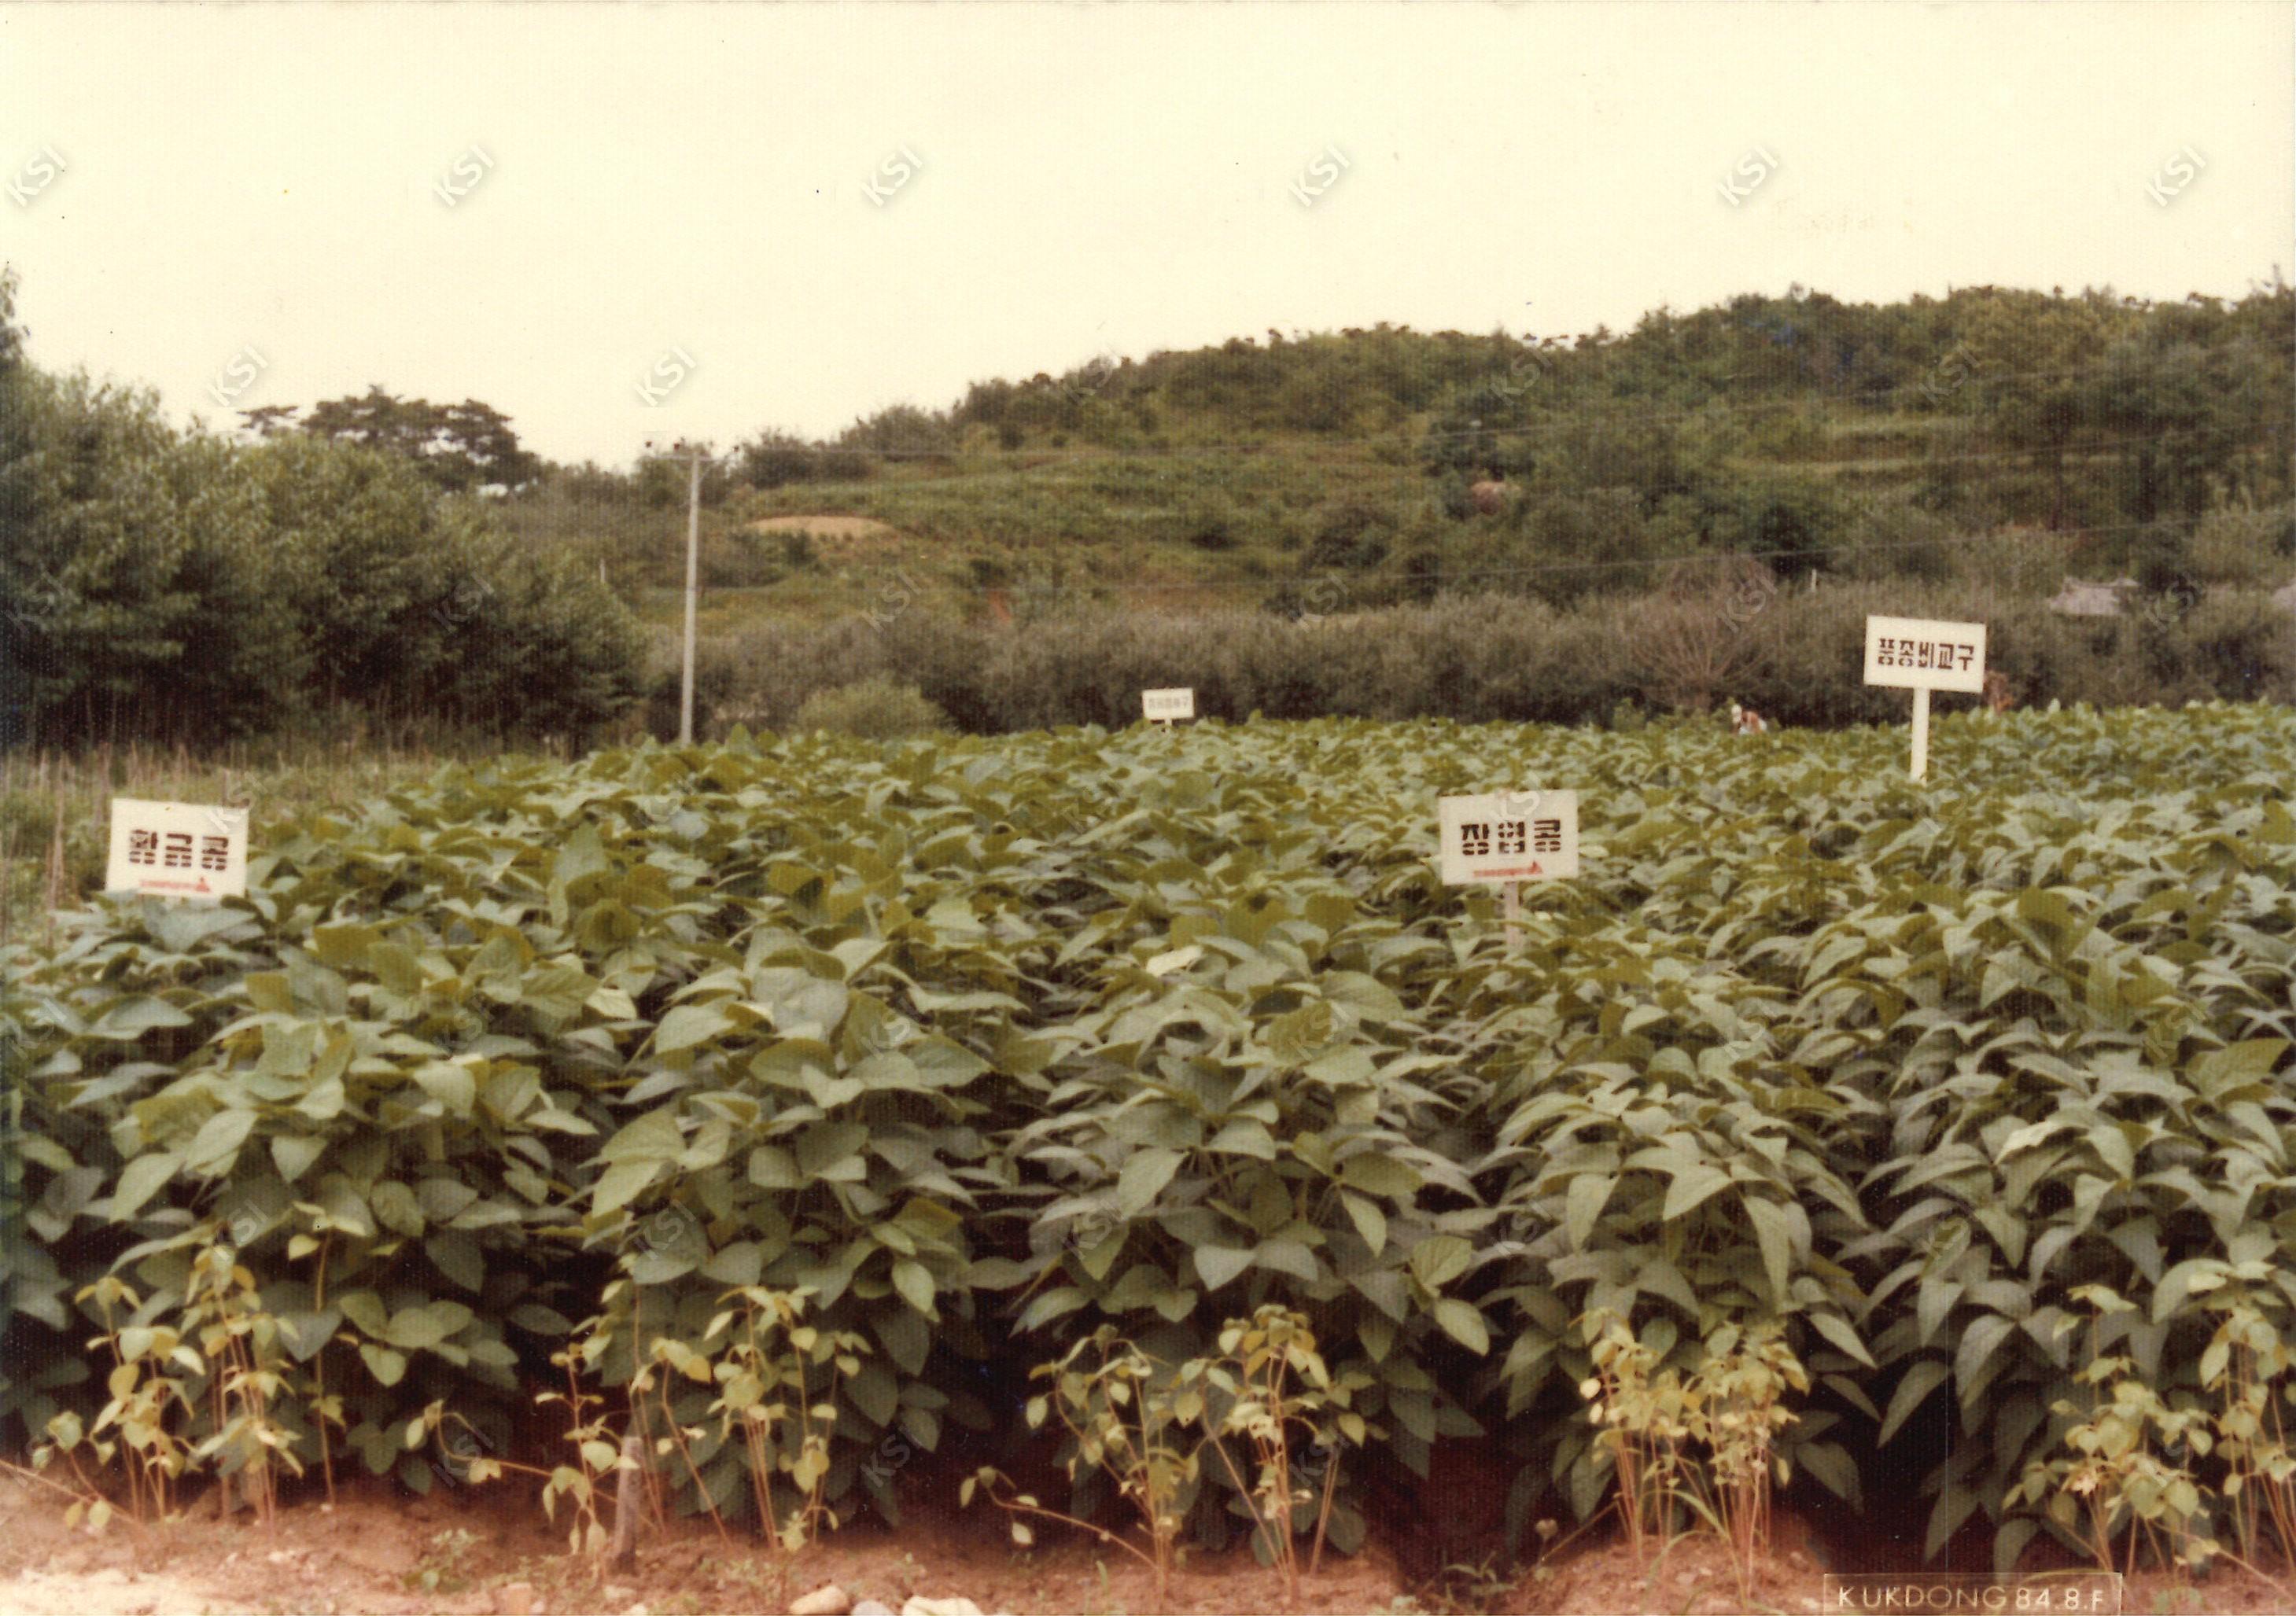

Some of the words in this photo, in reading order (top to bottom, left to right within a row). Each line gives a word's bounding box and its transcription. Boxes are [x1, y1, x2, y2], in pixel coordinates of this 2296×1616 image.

[1878, 638, 1975, 671] 품종비교구
[129, 829, 229, 871] 황금콩
[1461, 819, 1561, 856] 장엽콩
